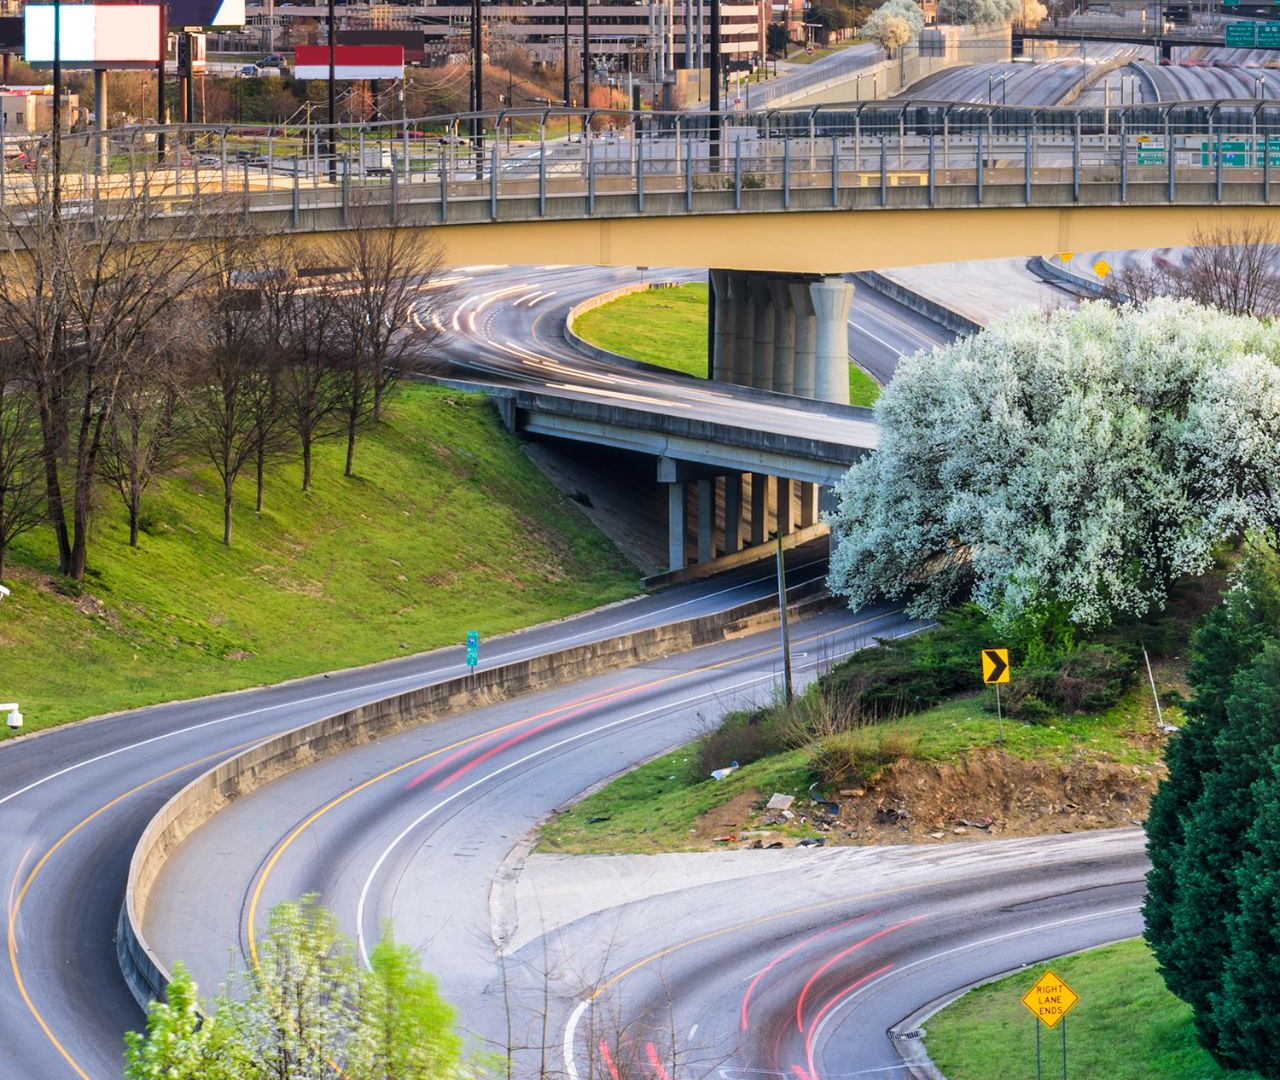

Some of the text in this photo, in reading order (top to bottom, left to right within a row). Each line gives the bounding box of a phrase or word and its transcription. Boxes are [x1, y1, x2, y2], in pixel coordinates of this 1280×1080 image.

[1036, 985, 1063, 994] RIGHT
[1038, 996, 1062, 1004] LANE
[1039, 1007, 1063, 1015] ENDS
